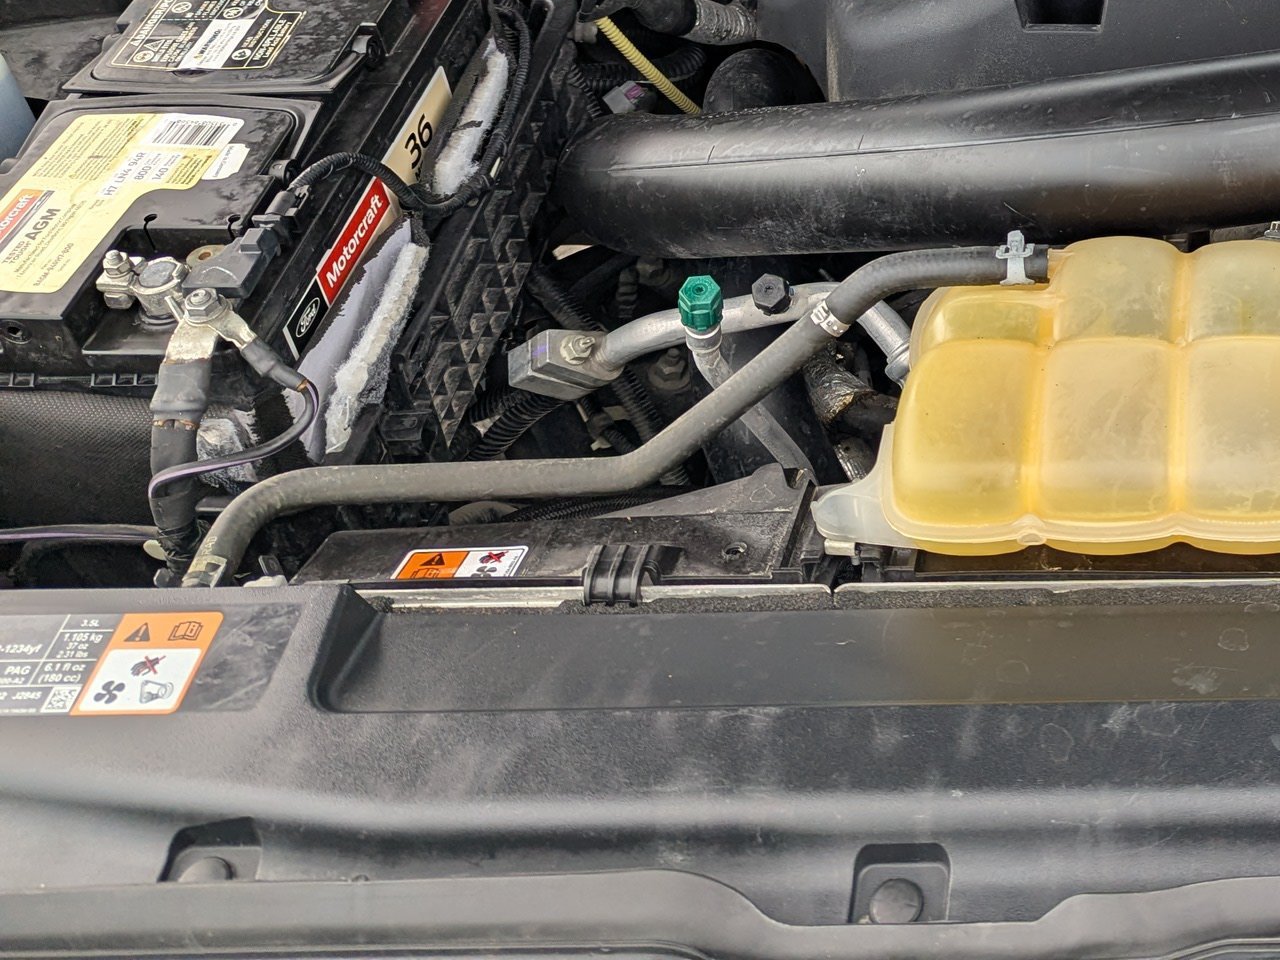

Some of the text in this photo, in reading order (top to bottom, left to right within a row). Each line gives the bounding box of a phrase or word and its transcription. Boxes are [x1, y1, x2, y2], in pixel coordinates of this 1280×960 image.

[405, 114, 432, 169] 36
[104, 153, 146, 195] H7 LN4 94R
[134, 166, 152, 179] 800
[152, 168, 169, 179] 140
[23, 208, 61, 240] AGM
[326, 194, 382, 288] Motorcraft
[2, 241, 25, 263] TESTED
[297, 302, 317, 334] Ford
[80, 619, 100, 627] 3.5L
[63, 633, 103, 644] 1.105 kg
[0, 644, 43, 656] -1234yf
[66, 642, 78, 650] 37
[56, 650, 73, 658] 2.31
[4, 665, 31, 675] PAG
[44, 663, 60, 671] 6.1
[38, 673, 62, 683] (180
[63, 674, 81, 683] cc)
